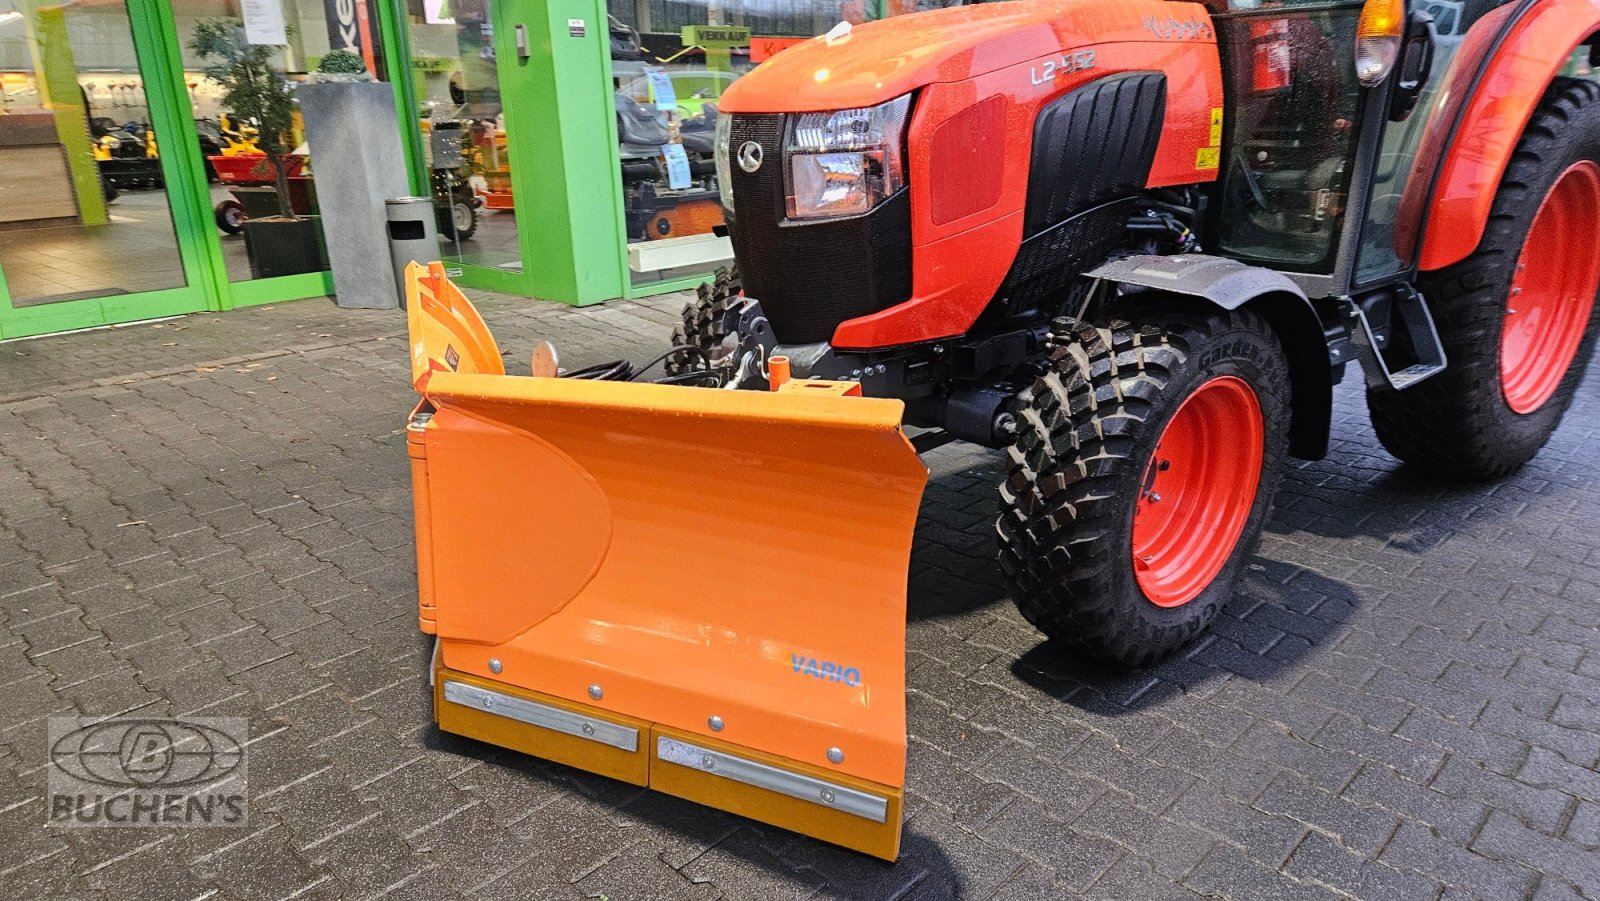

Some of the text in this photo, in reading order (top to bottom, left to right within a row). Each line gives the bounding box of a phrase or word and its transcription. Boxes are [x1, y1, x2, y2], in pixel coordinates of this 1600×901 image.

[697, 30, 748, 41] VERKAUF
[1142, 15, 1212, 39] Kubota
[791, 654, 862, 687] VARIO
